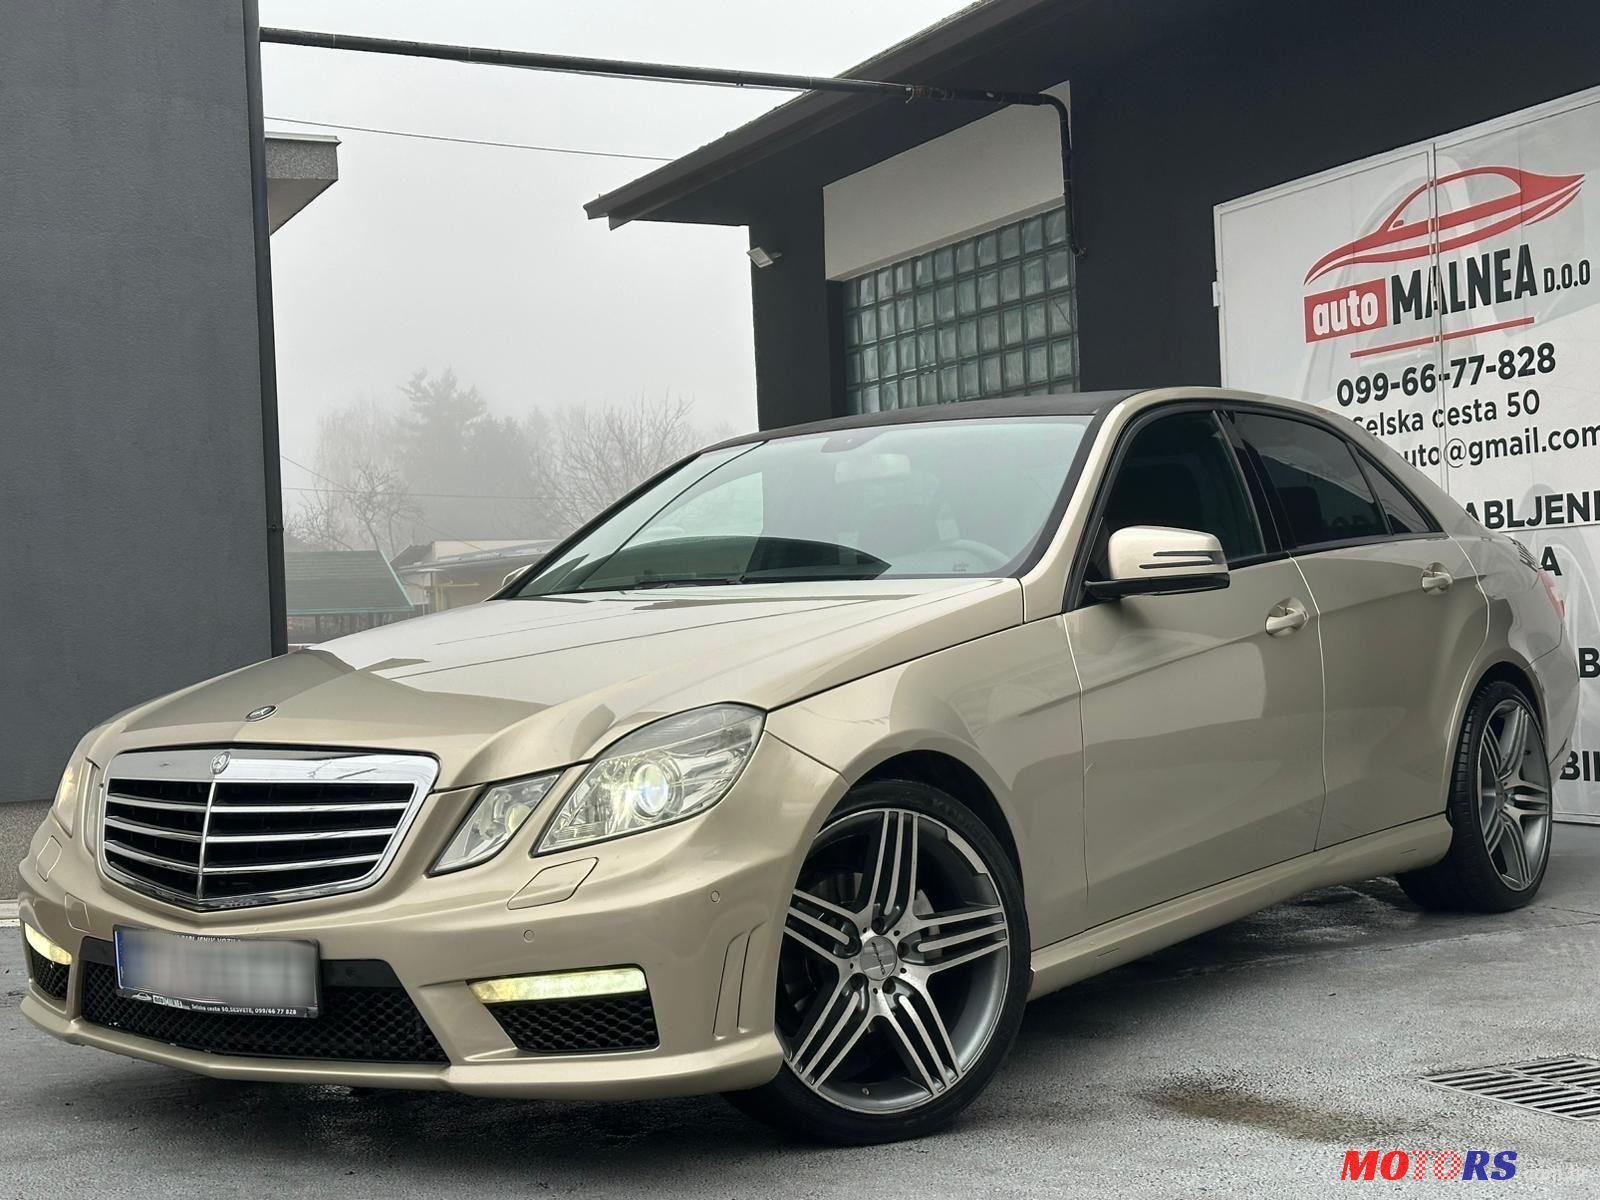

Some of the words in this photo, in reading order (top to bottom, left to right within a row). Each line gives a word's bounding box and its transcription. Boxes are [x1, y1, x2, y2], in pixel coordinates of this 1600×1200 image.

[1312, 290, 1379, 335] auto
[1391, 244, 1538, 325] MALNEA
[1543, 260, 1591, 293] D.O.O
[1337, 343, 1556, 406] 099-66-77-828
[1433, 399, 1497, 428] cesta
[1507, 389, 1540, 417] 50
